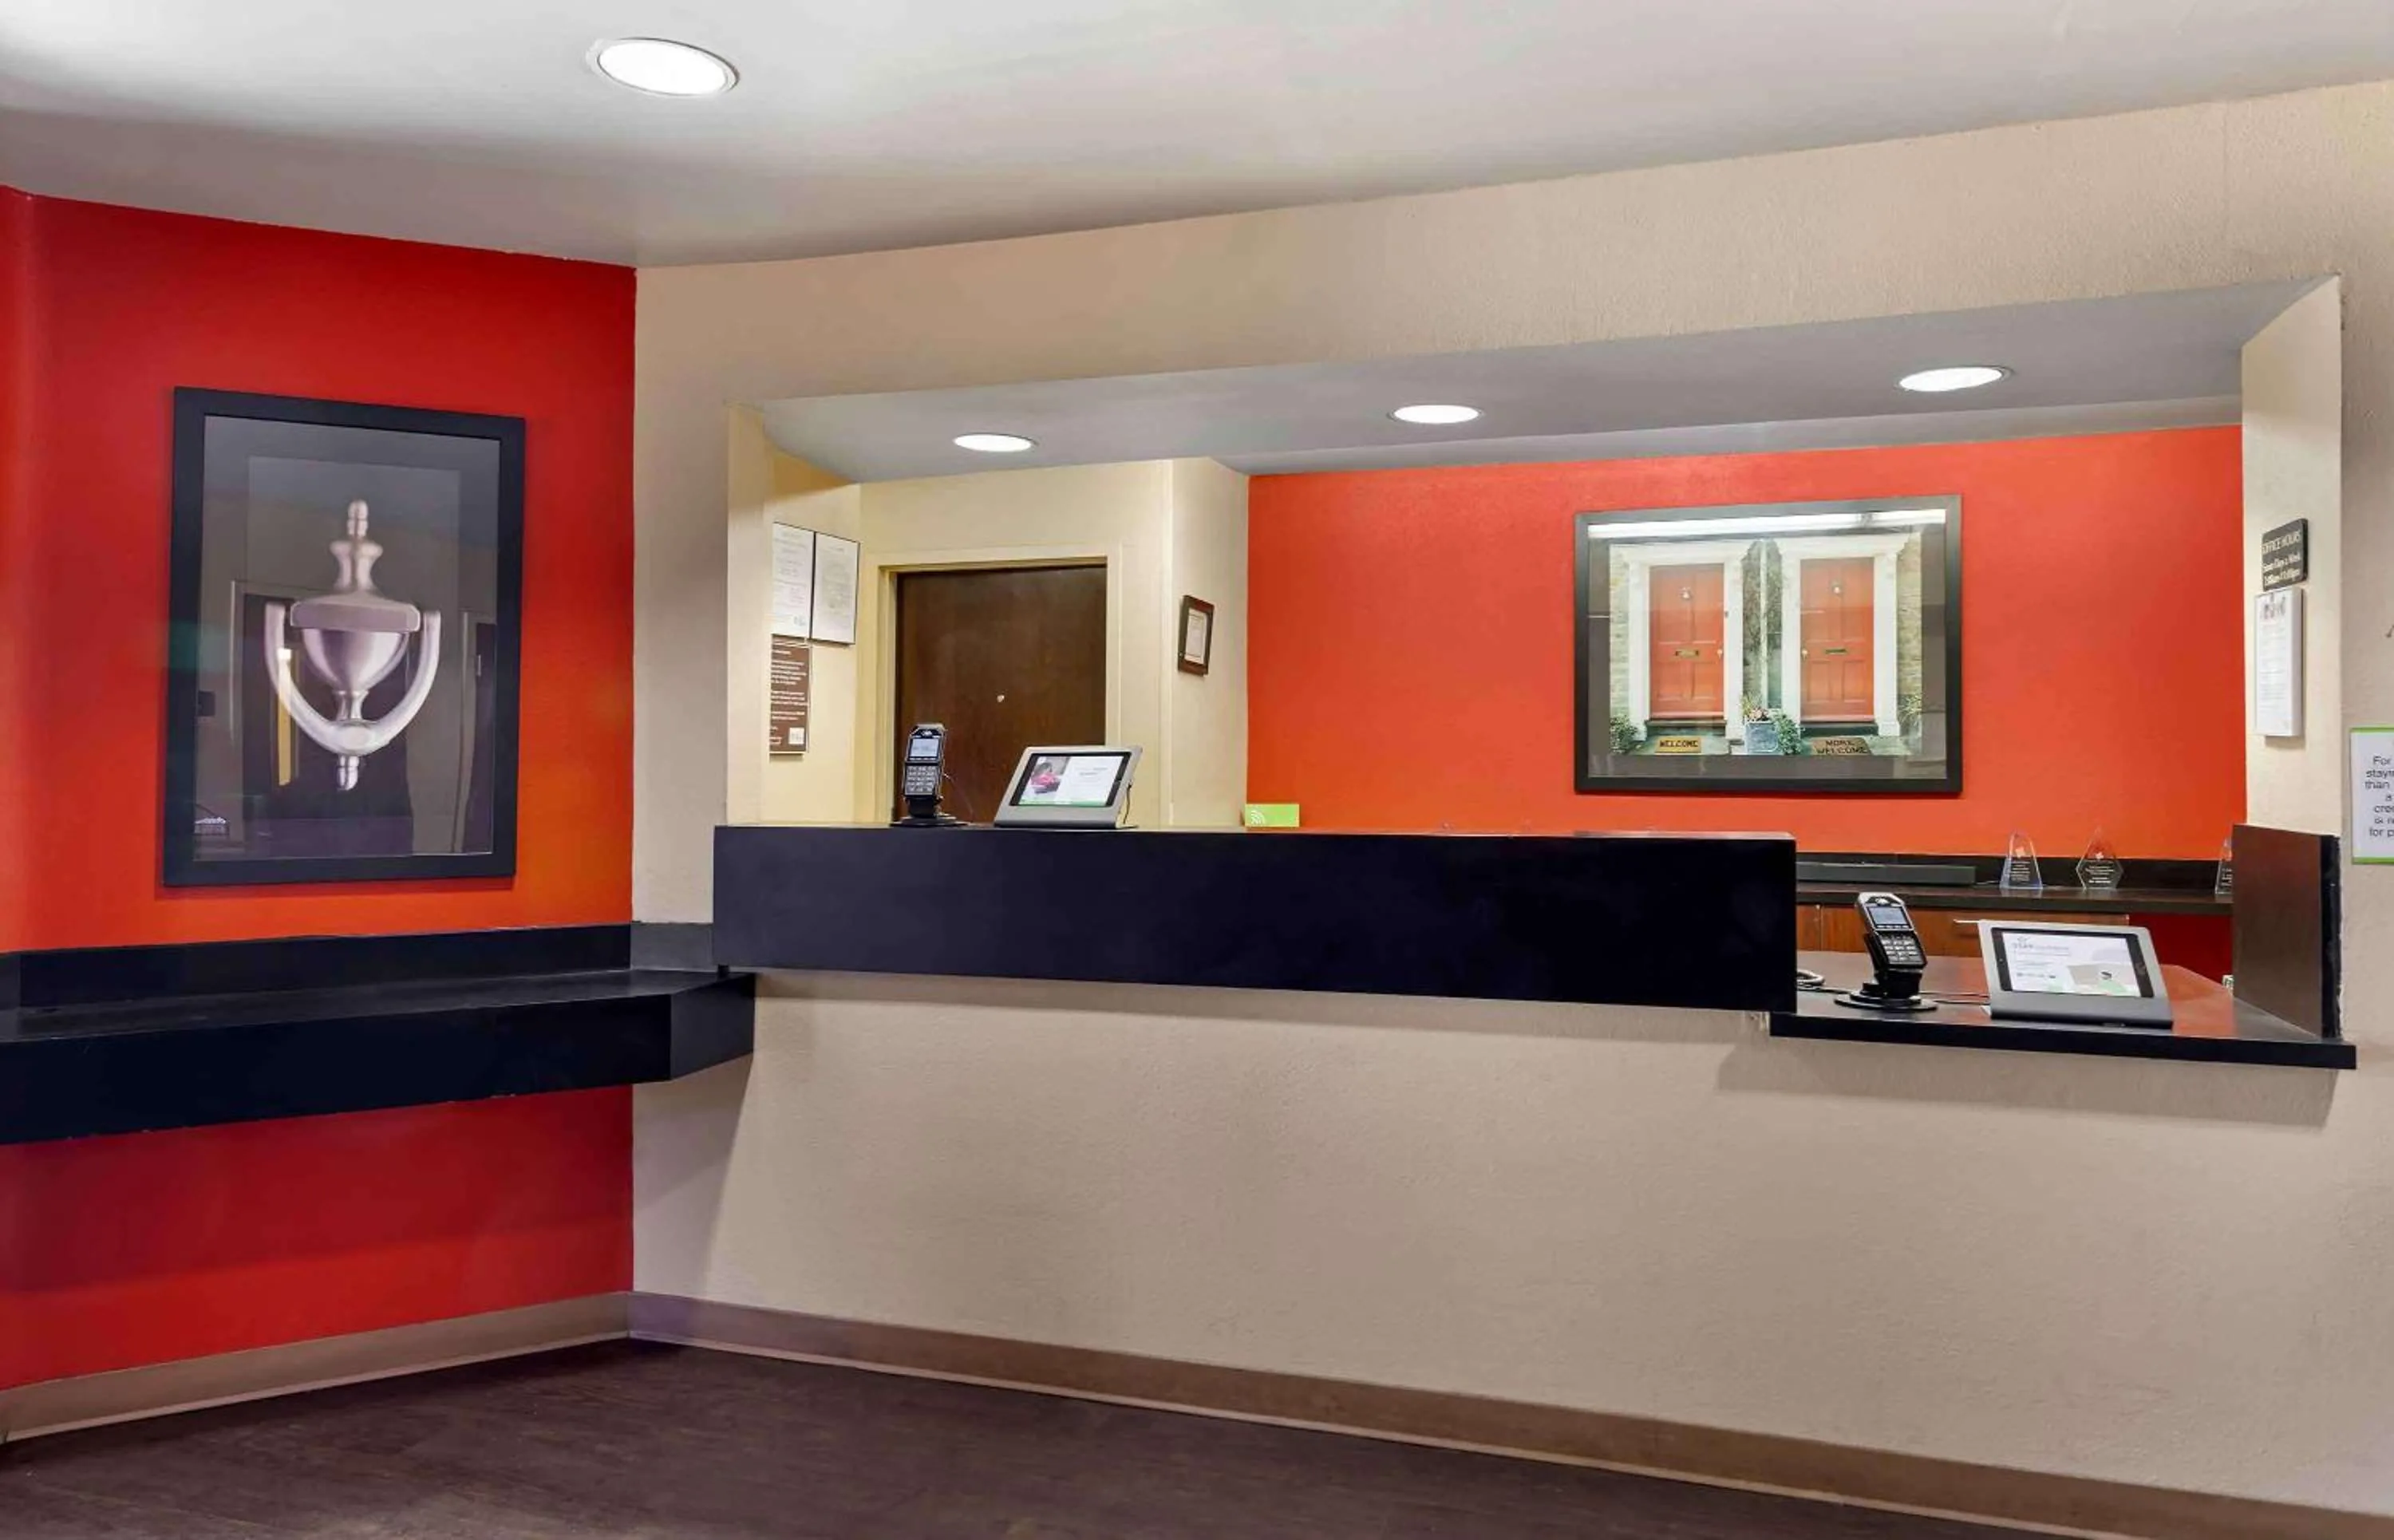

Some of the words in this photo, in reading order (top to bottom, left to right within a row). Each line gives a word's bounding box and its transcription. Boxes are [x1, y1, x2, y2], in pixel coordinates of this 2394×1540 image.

[2373, 756, 2391, 765] For
[2364, 780, 2390, 789] than
[2369, 827, 2383, 837] for
